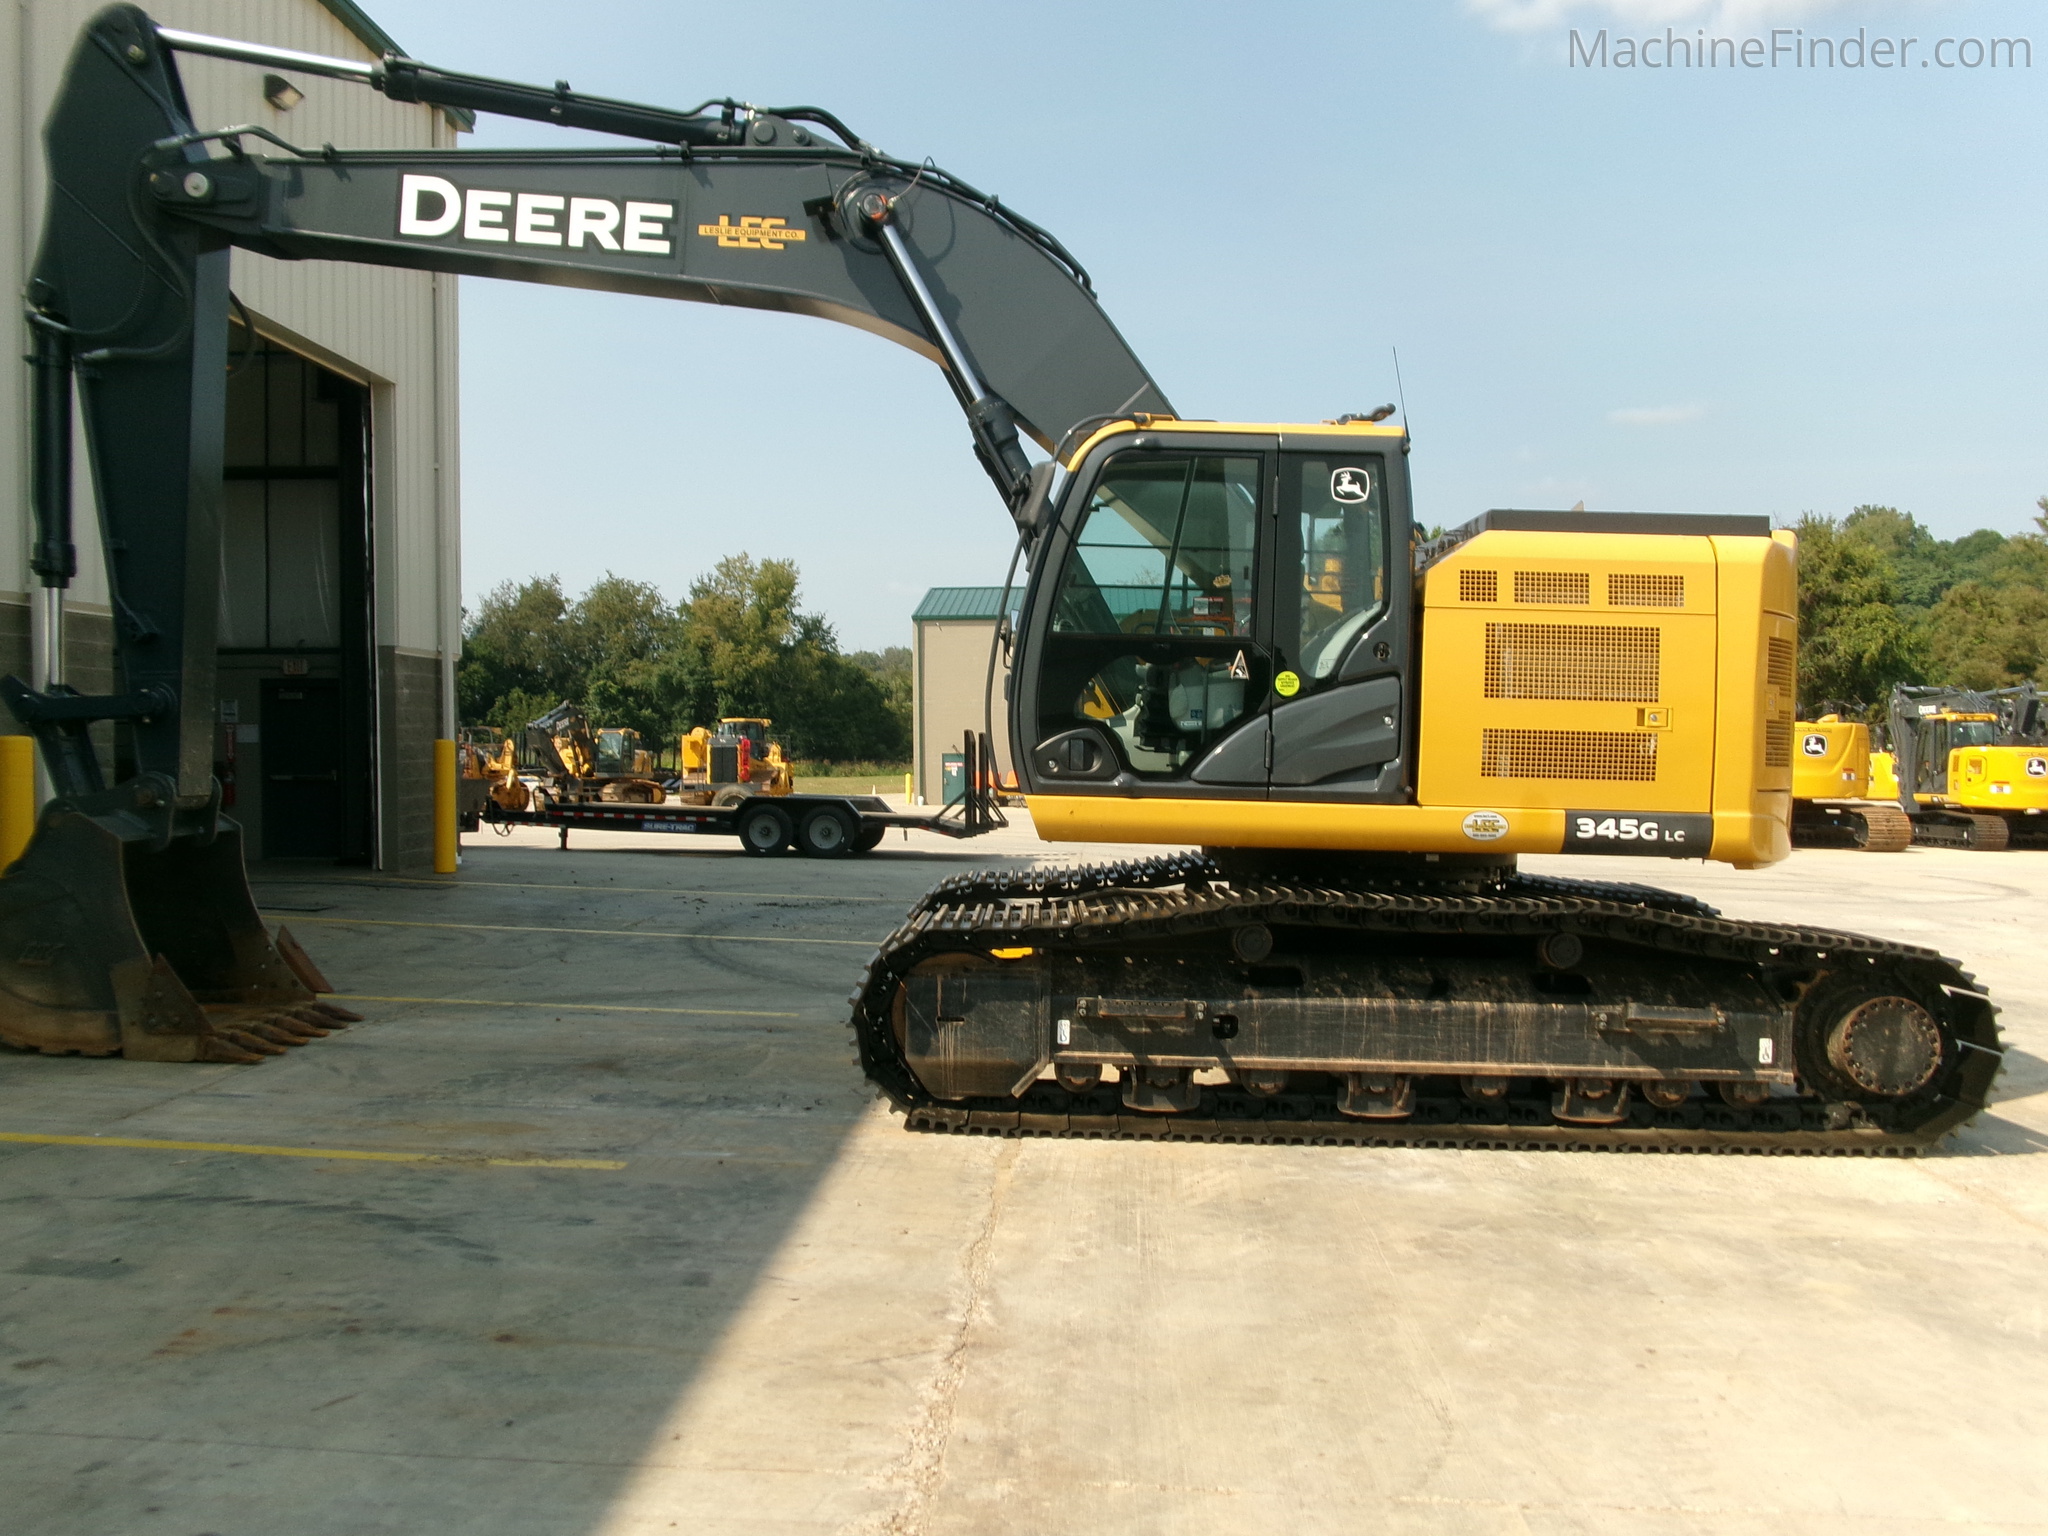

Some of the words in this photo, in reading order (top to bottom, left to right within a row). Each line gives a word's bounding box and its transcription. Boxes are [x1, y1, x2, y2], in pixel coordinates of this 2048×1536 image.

[399, 173, 674, 255] DEERE
[704, 226, 733, 236] LESLIE
[734, 228, 783, 239] EQUIPMENT
[784, 230, 800, 240] CO.
[1576, 817, 1659, 841] 345G
[1664, 829, 1685, 842] LC
